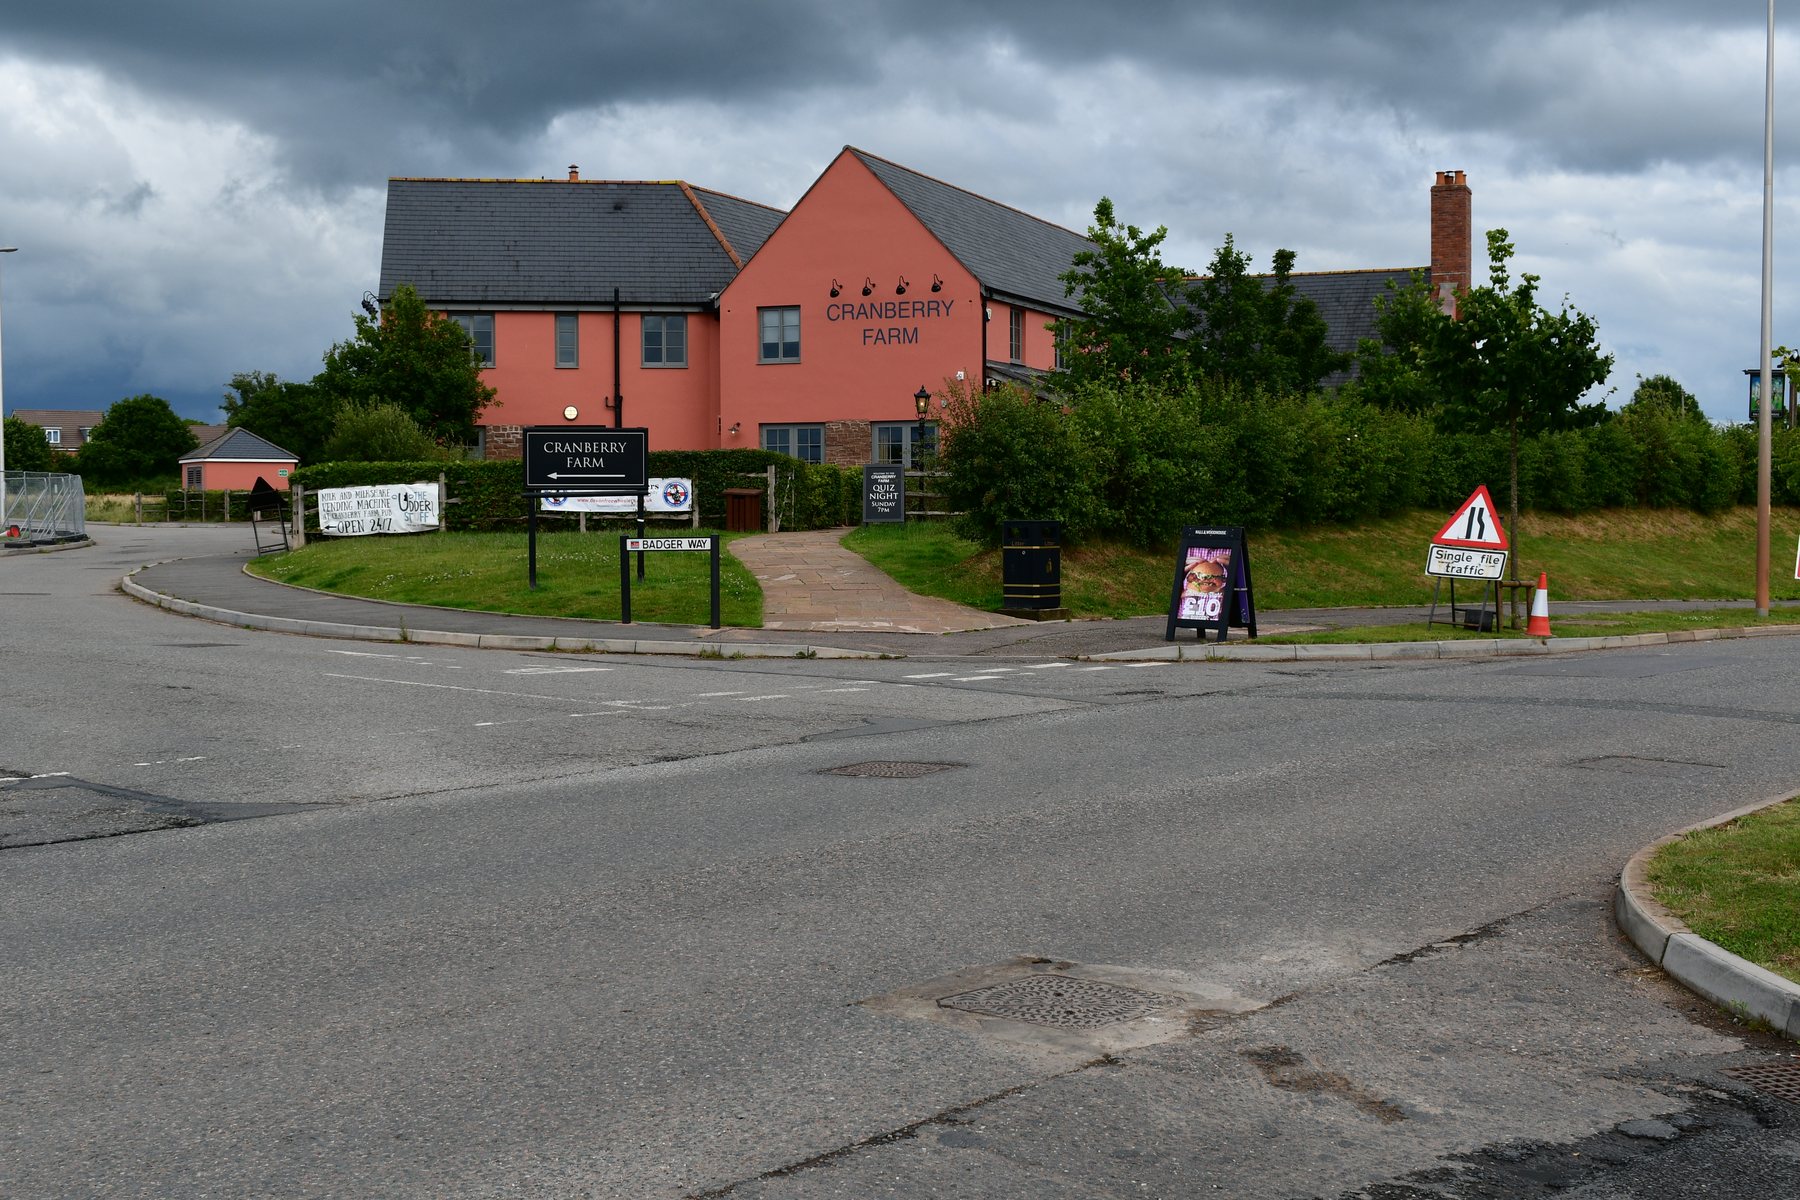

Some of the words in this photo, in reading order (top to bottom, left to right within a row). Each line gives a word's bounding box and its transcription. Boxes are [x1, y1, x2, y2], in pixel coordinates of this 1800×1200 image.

[827, 300, 954, 321] CRANBERRY
[863, 327, 918, 345] FARM
[543, 441, 627, 454] CRANBERRY
[566, 457, 605, 468] FARM
[872, 484, 895, 492] QUIZ
[321, 492, 336, 501] MILK
[340, 492, 352, 500] AND
[355, 489, 391, 498] MILKSHAKE
[413, 491, 427, 500] THE
[322, 501, 352, 512] VENDING
[357, 498, 391, 510] MACHINE
[337, 520, 365, 534] OPEN
[642, 540, 683, 549] BADGER
[687, 539, 707, 549] WAY
[1435, 549, 1472, 563] Single
[1480, 554, 1500, 564] file
[1445, 563, 1484, 575] traffic
[1184, 597, 1220, 616] £10
